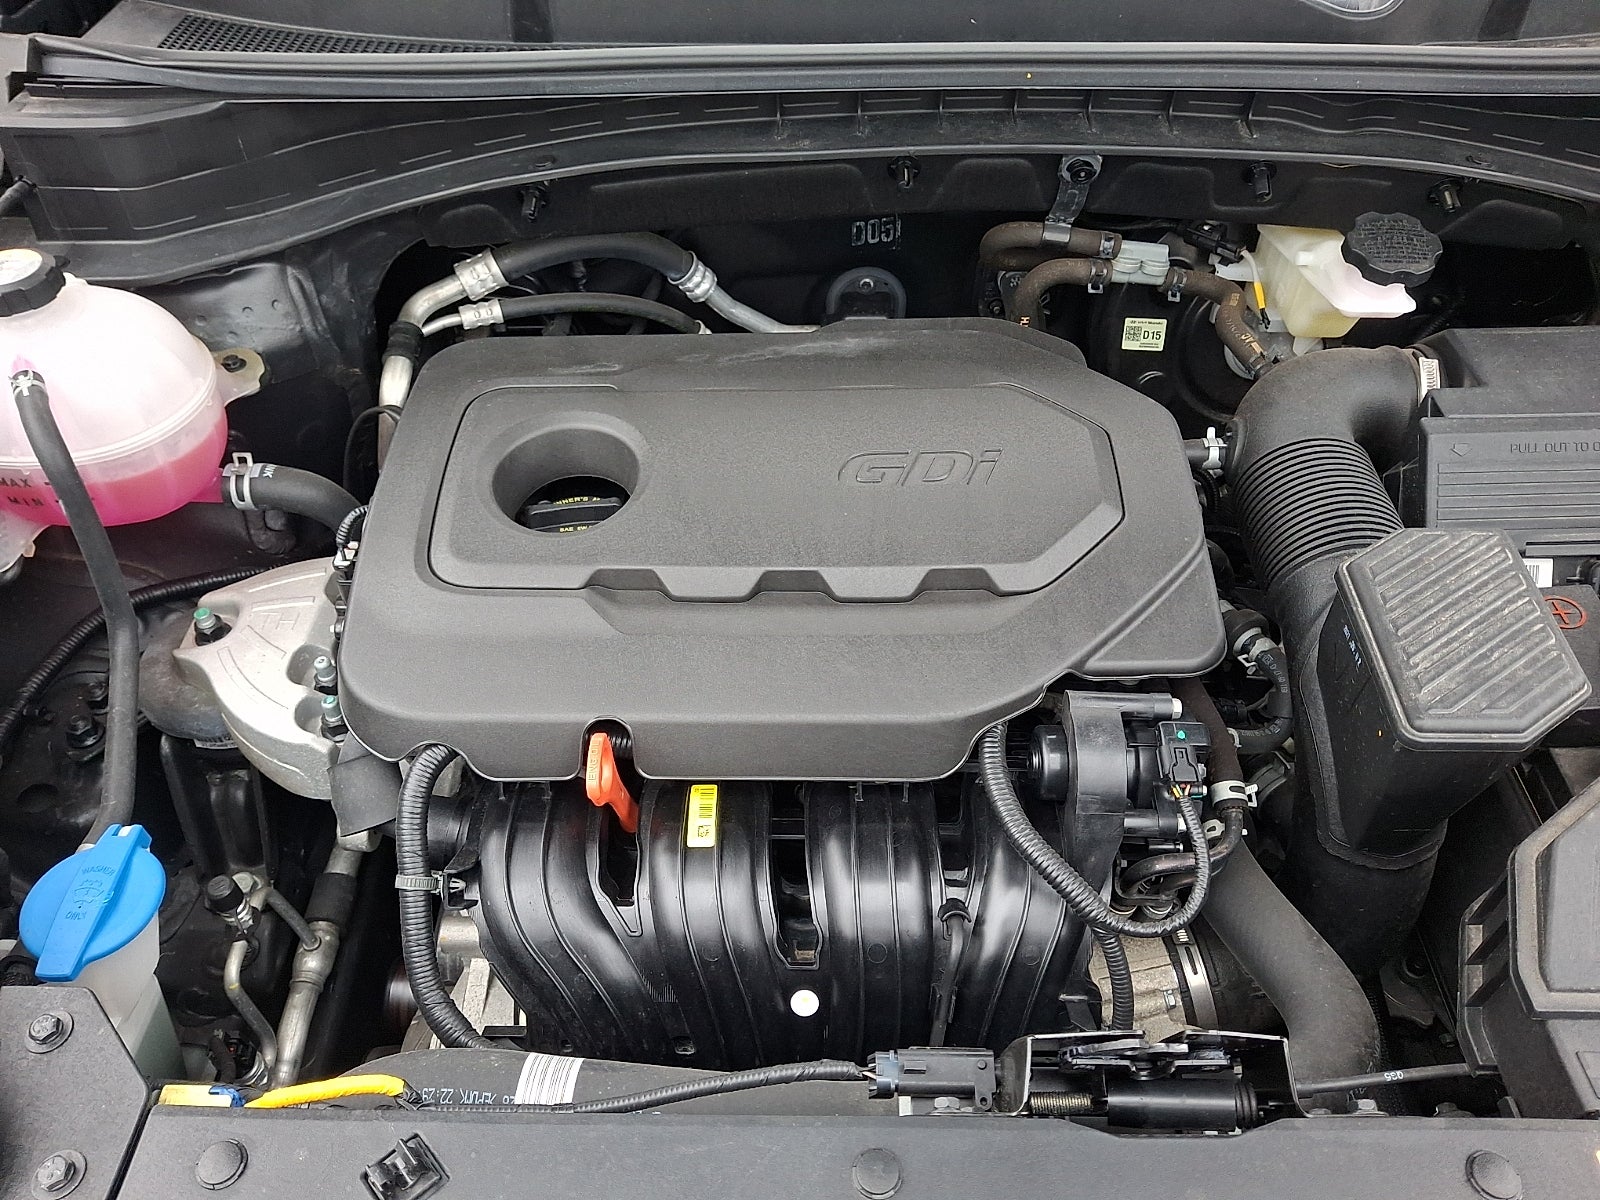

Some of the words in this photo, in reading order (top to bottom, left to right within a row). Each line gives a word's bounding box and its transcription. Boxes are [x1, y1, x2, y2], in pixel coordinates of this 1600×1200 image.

[1142, 330, 1162, 341] D15
[1510, 442, 1537, 454] PULL
[1544, 441, 1571, 453] OUT
[1572, 441, 1590, 452] TO
[837, 449, 1003, 487] GDi
[81, 864, 117, 877] WASHER
